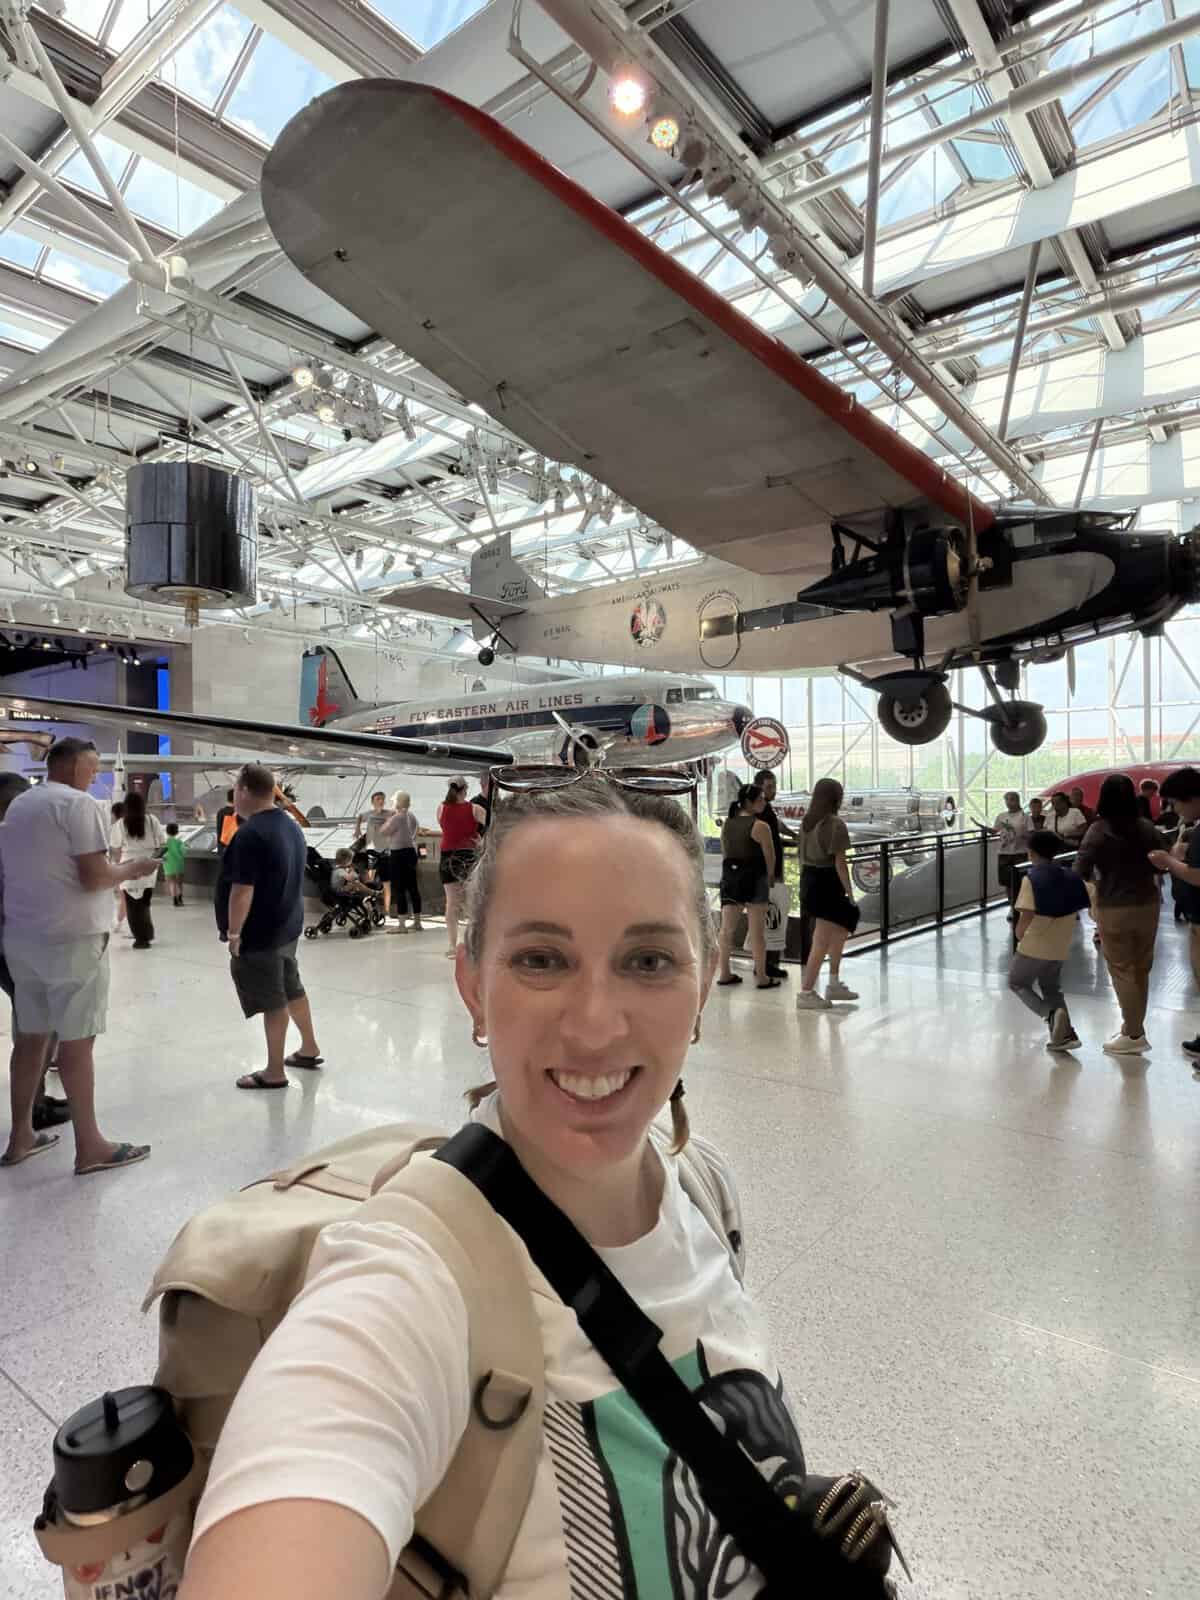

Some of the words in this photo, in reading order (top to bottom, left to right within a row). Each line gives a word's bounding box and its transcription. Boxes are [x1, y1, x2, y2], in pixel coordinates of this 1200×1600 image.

[500, 578, 528, 598] Ford
[505, 699, 529, 712] AIR
[538, 693, 583, 708] LINES
